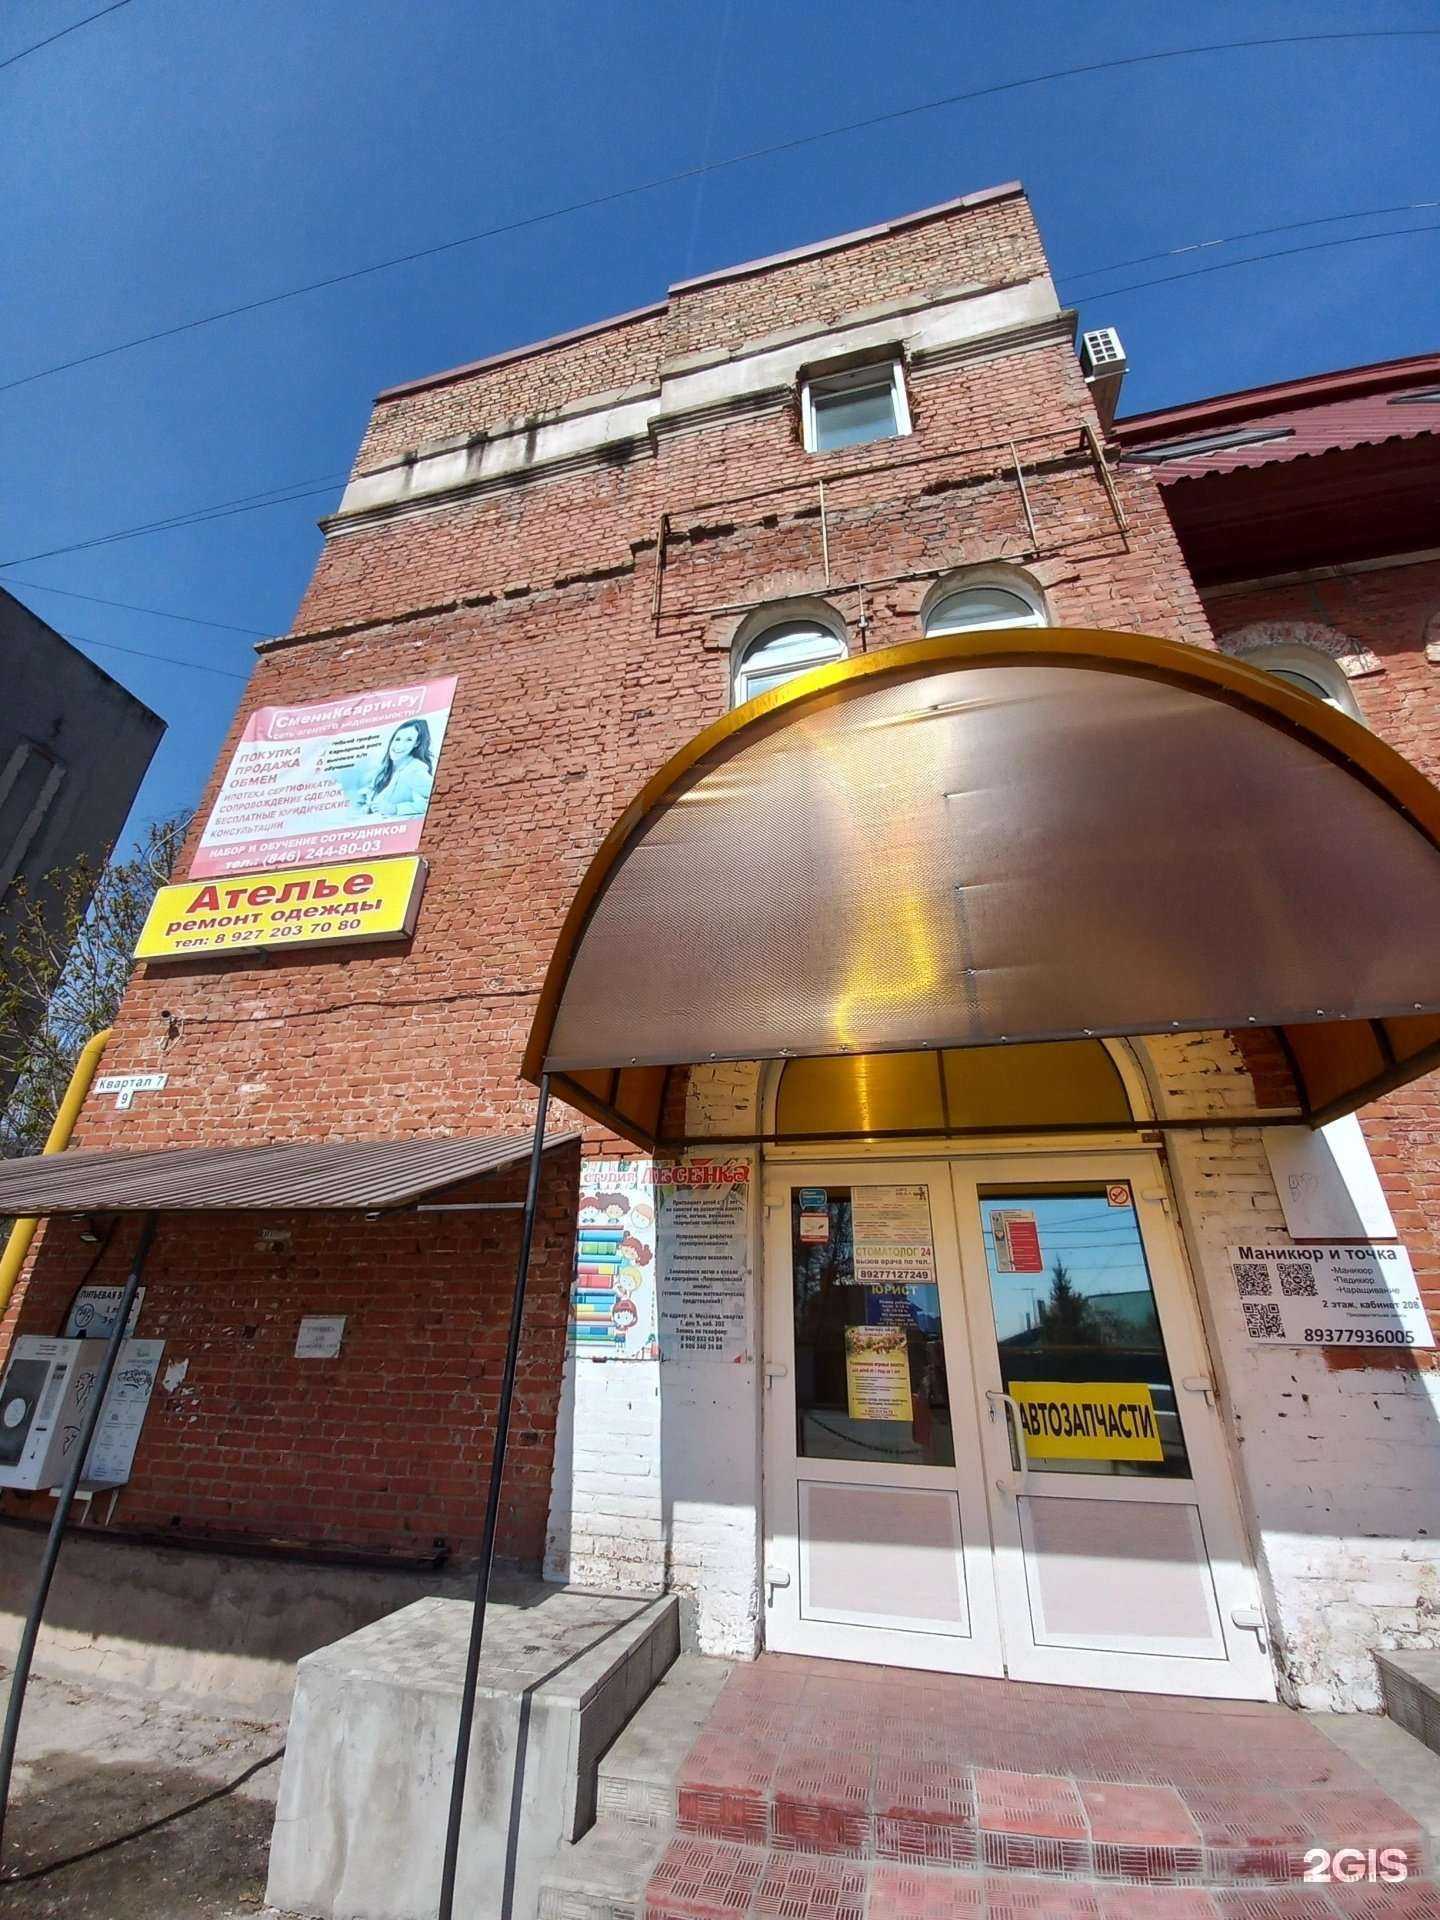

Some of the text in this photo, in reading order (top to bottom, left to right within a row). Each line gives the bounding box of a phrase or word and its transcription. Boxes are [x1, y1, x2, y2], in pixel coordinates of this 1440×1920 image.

[240, 747, 301, 763] ПОКУПКА
[235, 758, 301, 775] ПРОДАЖА
[229, 774, 278, 788] ОБМЕН
[223, 779, 338, 801] ИПОТЕКА СЕРТИФИКАТЫ
[219, 790, 343, 813] СОПРОВОЖДЕНИЕ СДЕЛОК
[215, 800, 351, 825] БЕСПЛАТНЫЕ ЮРИДИЧЕСКИЕ
[210, 822, 284, 838] КОНСУЛЬТАЦИИ
[208, 825, 408, 858] НАБОР И ОБУЧЕНИЕ СОТРУДНИКОВ
[262, 849, 300, 867] (846)
[305, 840, 382, 860] 244-80-03
[185, 873, 374, 914] Ателье
[165, 898, 383, 936] ремонт одежды
[174, 918, 361, 948] тел: 8 927 203 70 80
[99, 1075, 164, 1090] Квартал 7
[121, 1092, 128, 1104] 9
[856, 1247, 931, 1257] СТОМАТОЛОГ 24
[1238, 1246, 1398, 1263] Маникюр и точка
[860, 1270, 929, 1279] 89277127249
[872, 1285, 919, 1295] ЮРИСТ
[1322, 1300, 1329, 1308] 2
[1360, 1300, 1400, 1309] кабинет
[1304, 1328, 1415, 1344] 89377936005
[1019, 1402, 1155, 1438] АВТОЗАПЧАСТИ
